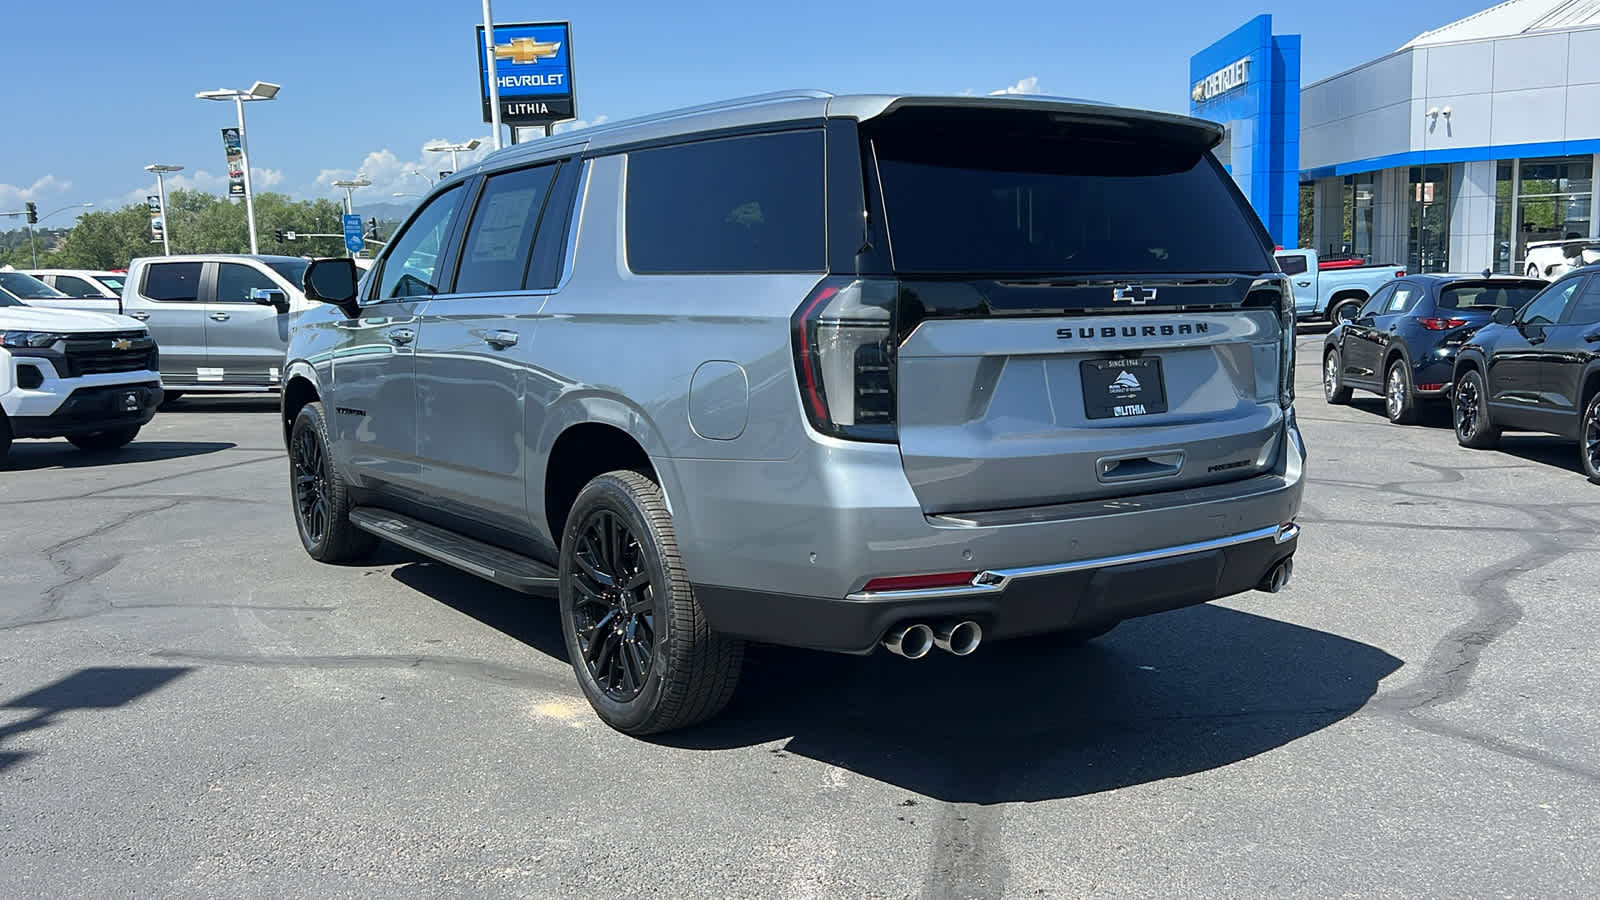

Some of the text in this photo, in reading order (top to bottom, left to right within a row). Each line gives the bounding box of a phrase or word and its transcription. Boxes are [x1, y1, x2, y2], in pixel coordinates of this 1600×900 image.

[497, 74, 563, 87] HEVROLET
[1205, 57, 1250, 99] CHEVROLET
[508, 103, 548, 115] LITHIA
[1056, 323, 1208, 339] SUBURBAN
[1108, 360, 1125, 368] SINCE
[1120, 404, 1146, 416] LITHIA
